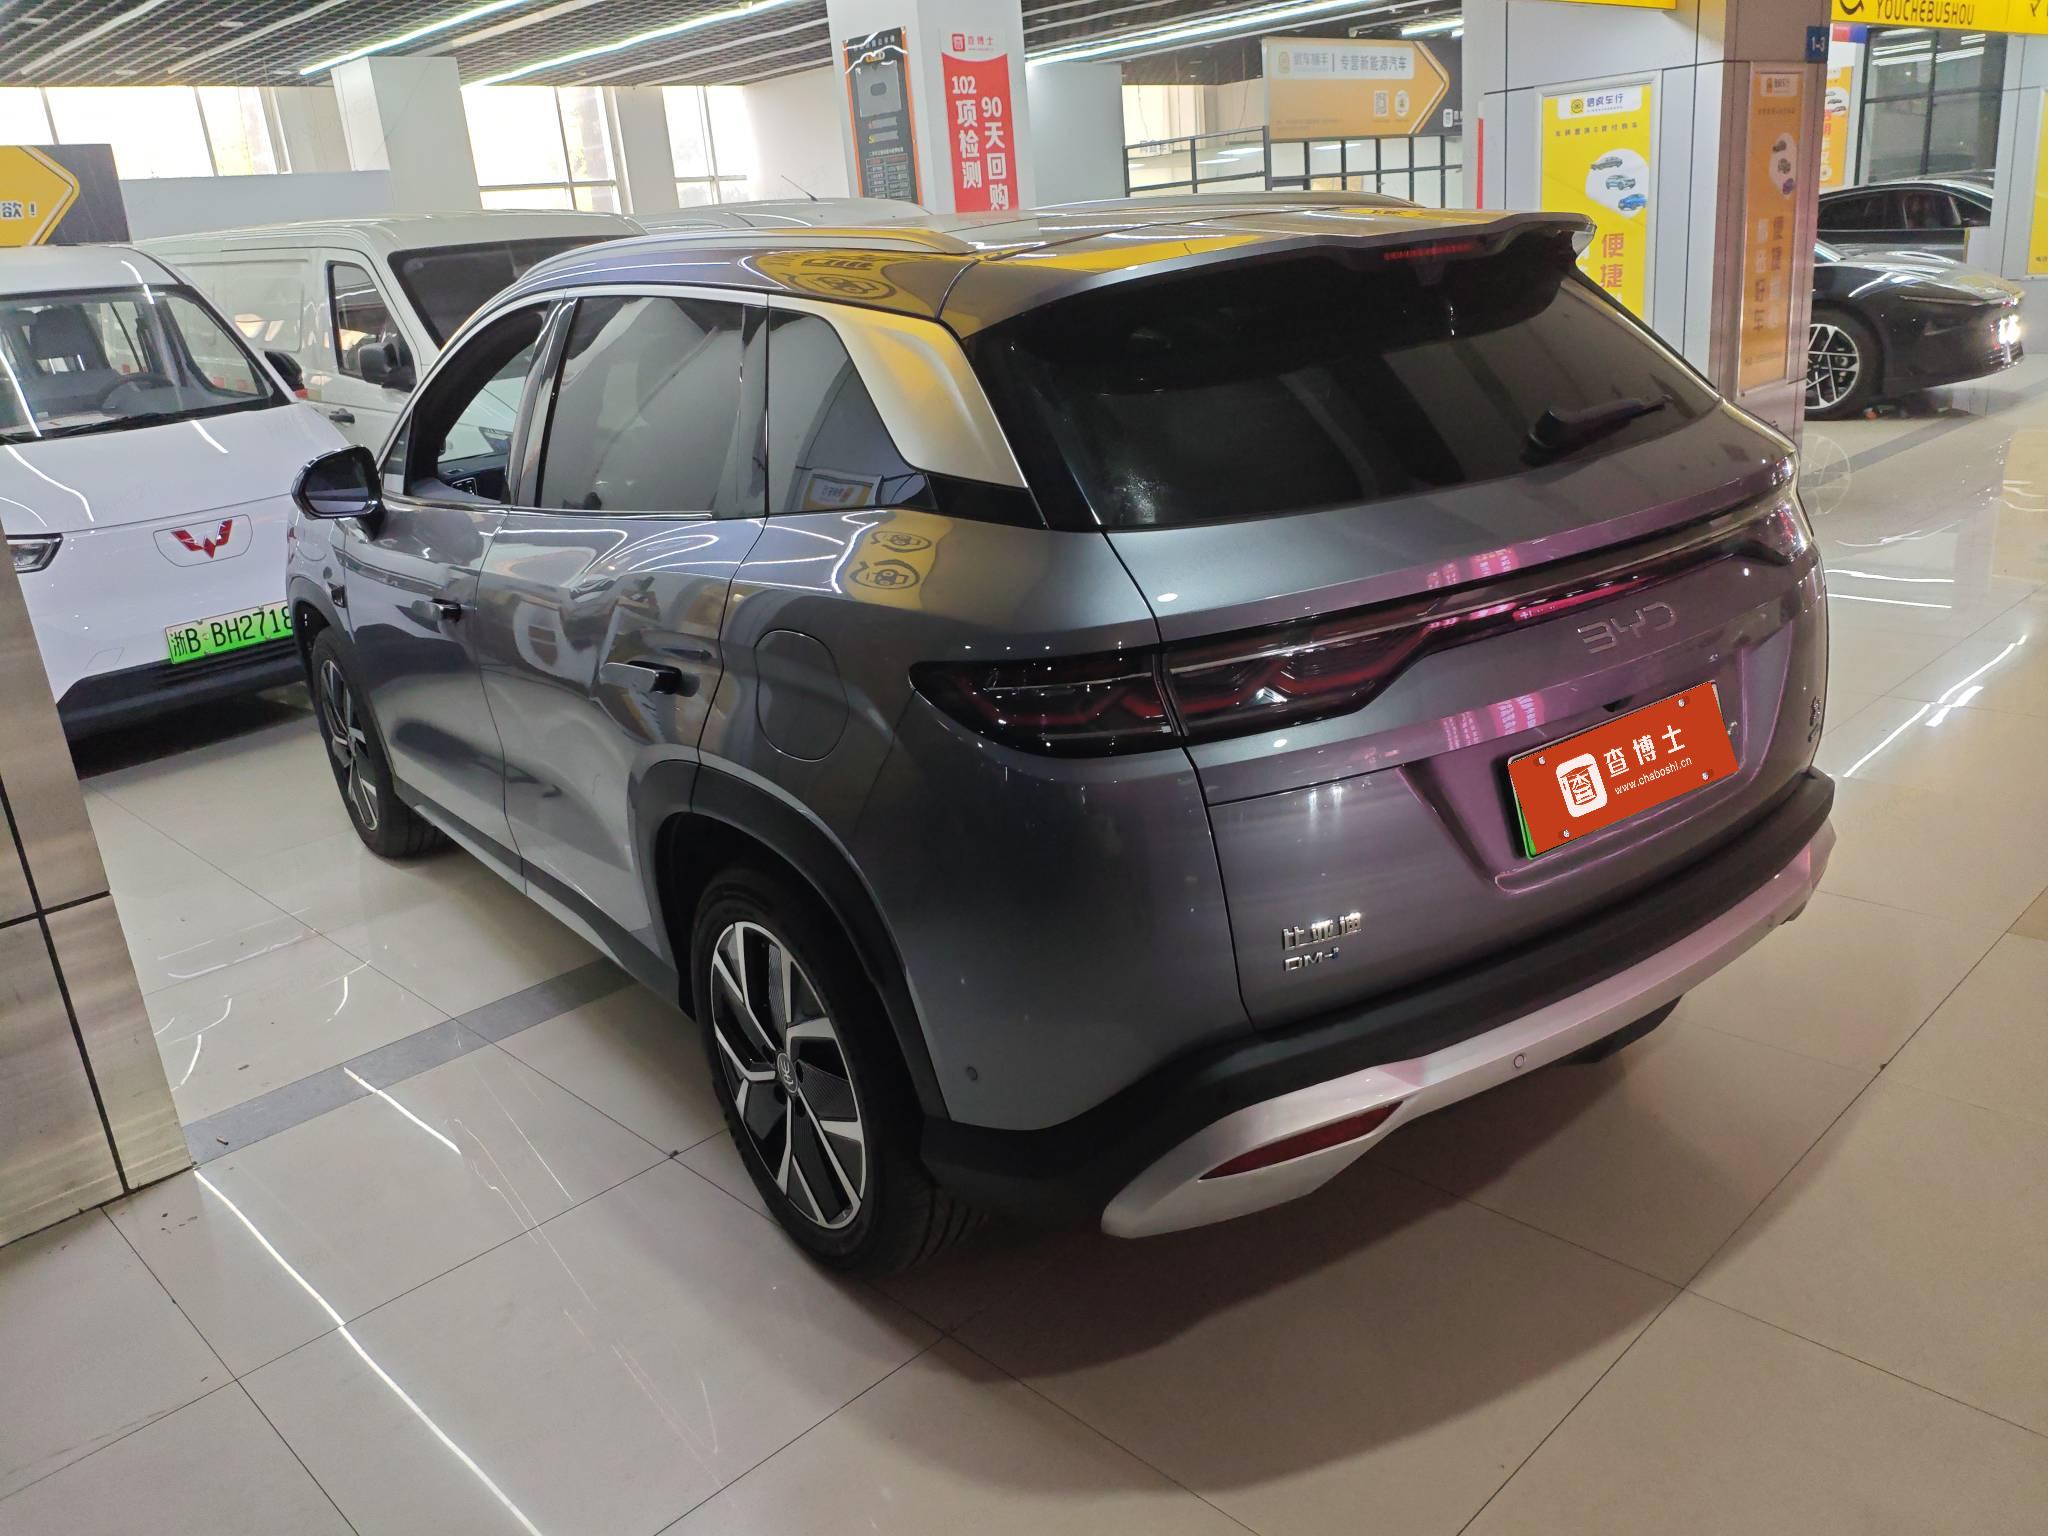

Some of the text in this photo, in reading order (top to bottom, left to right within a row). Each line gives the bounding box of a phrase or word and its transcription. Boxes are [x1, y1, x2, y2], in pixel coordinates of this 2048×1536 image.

[1877, 0, 1975, 25] YOUCHEBUSHOU
[1340, 55, 1407, 72] 专营新能源汽车
[1811, 36, 1825, 52] 1-3
[951, 76, 982, 188] 102项检测
[981, 97, 1008, 210] 90天回购
[1600, 233, 1624, 302] 便捷
[1577, 601, 1677, 654] BYD
